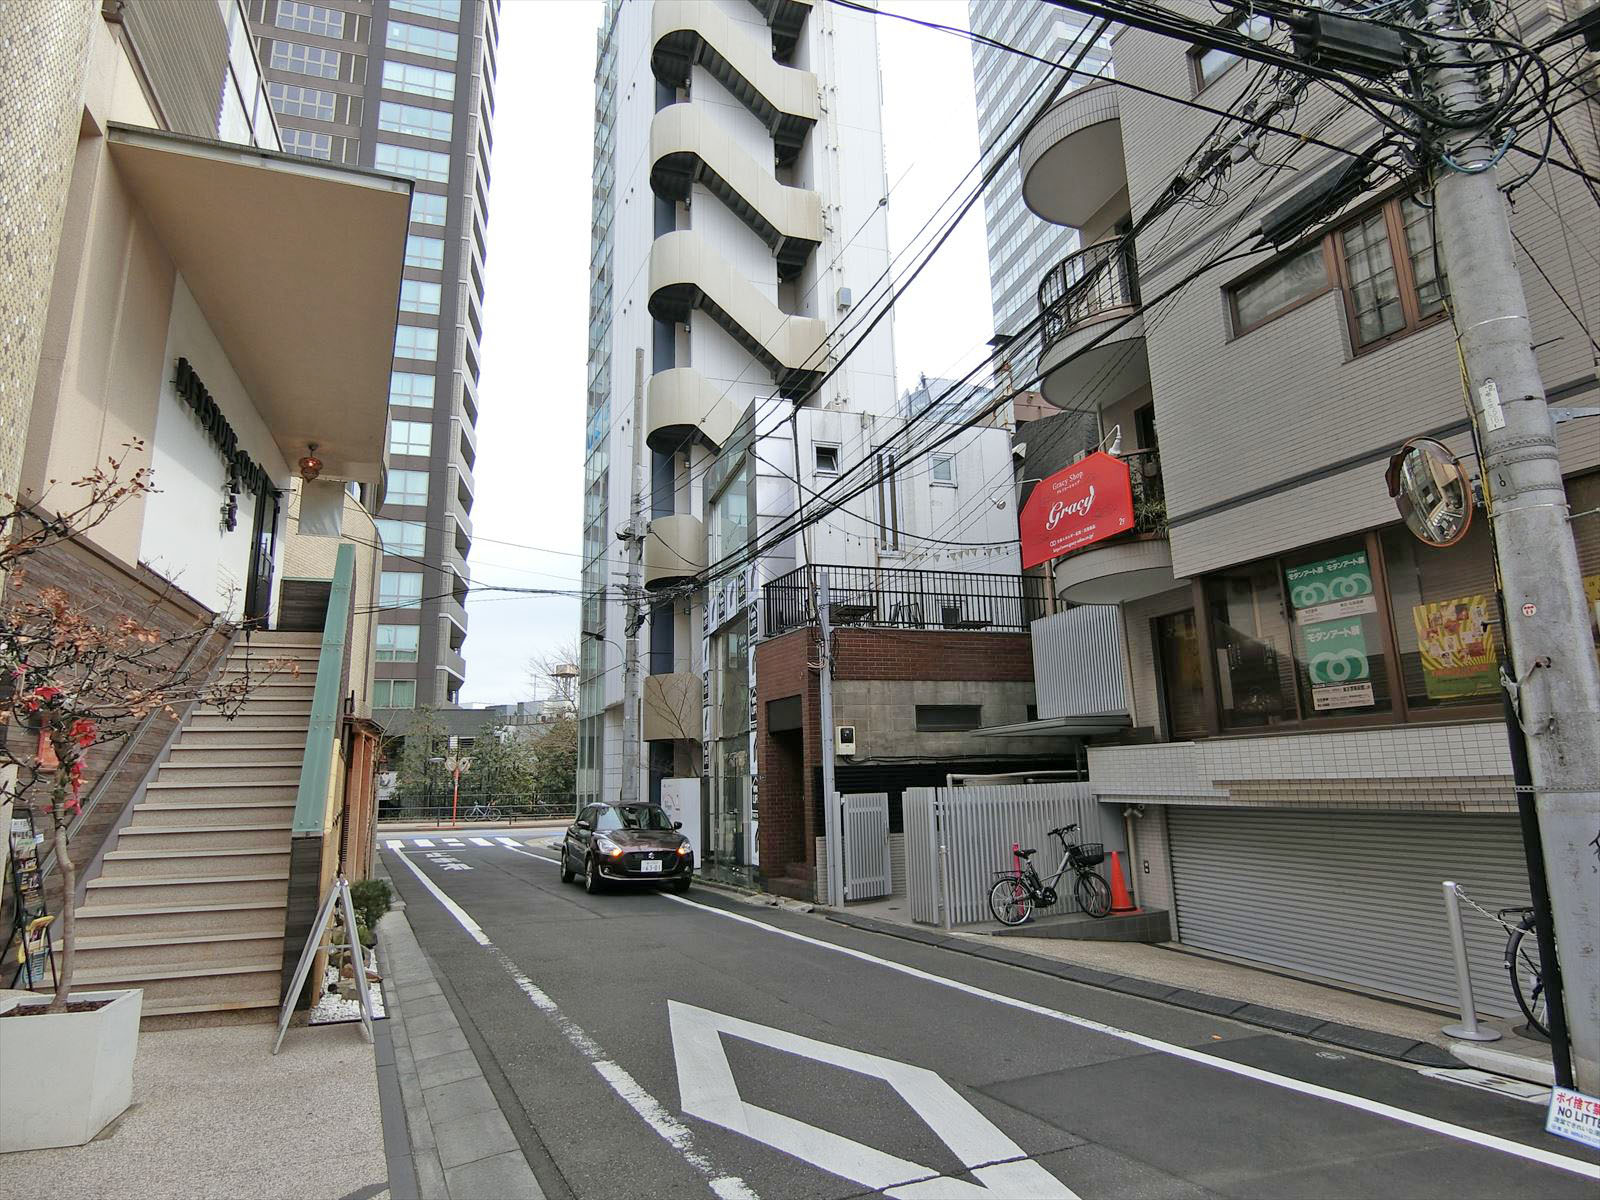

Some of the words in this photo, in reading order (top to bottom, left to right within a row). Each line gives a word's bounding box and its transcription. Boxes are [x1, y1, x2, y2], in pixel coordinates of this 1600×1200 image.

[1052, 480, 1068, 491] Gracy
[1069, 471, 1083, 482] Shop
[1046, 485, 1096, 531] Gracy
[1557, 1106, 1573, 1119] NO
